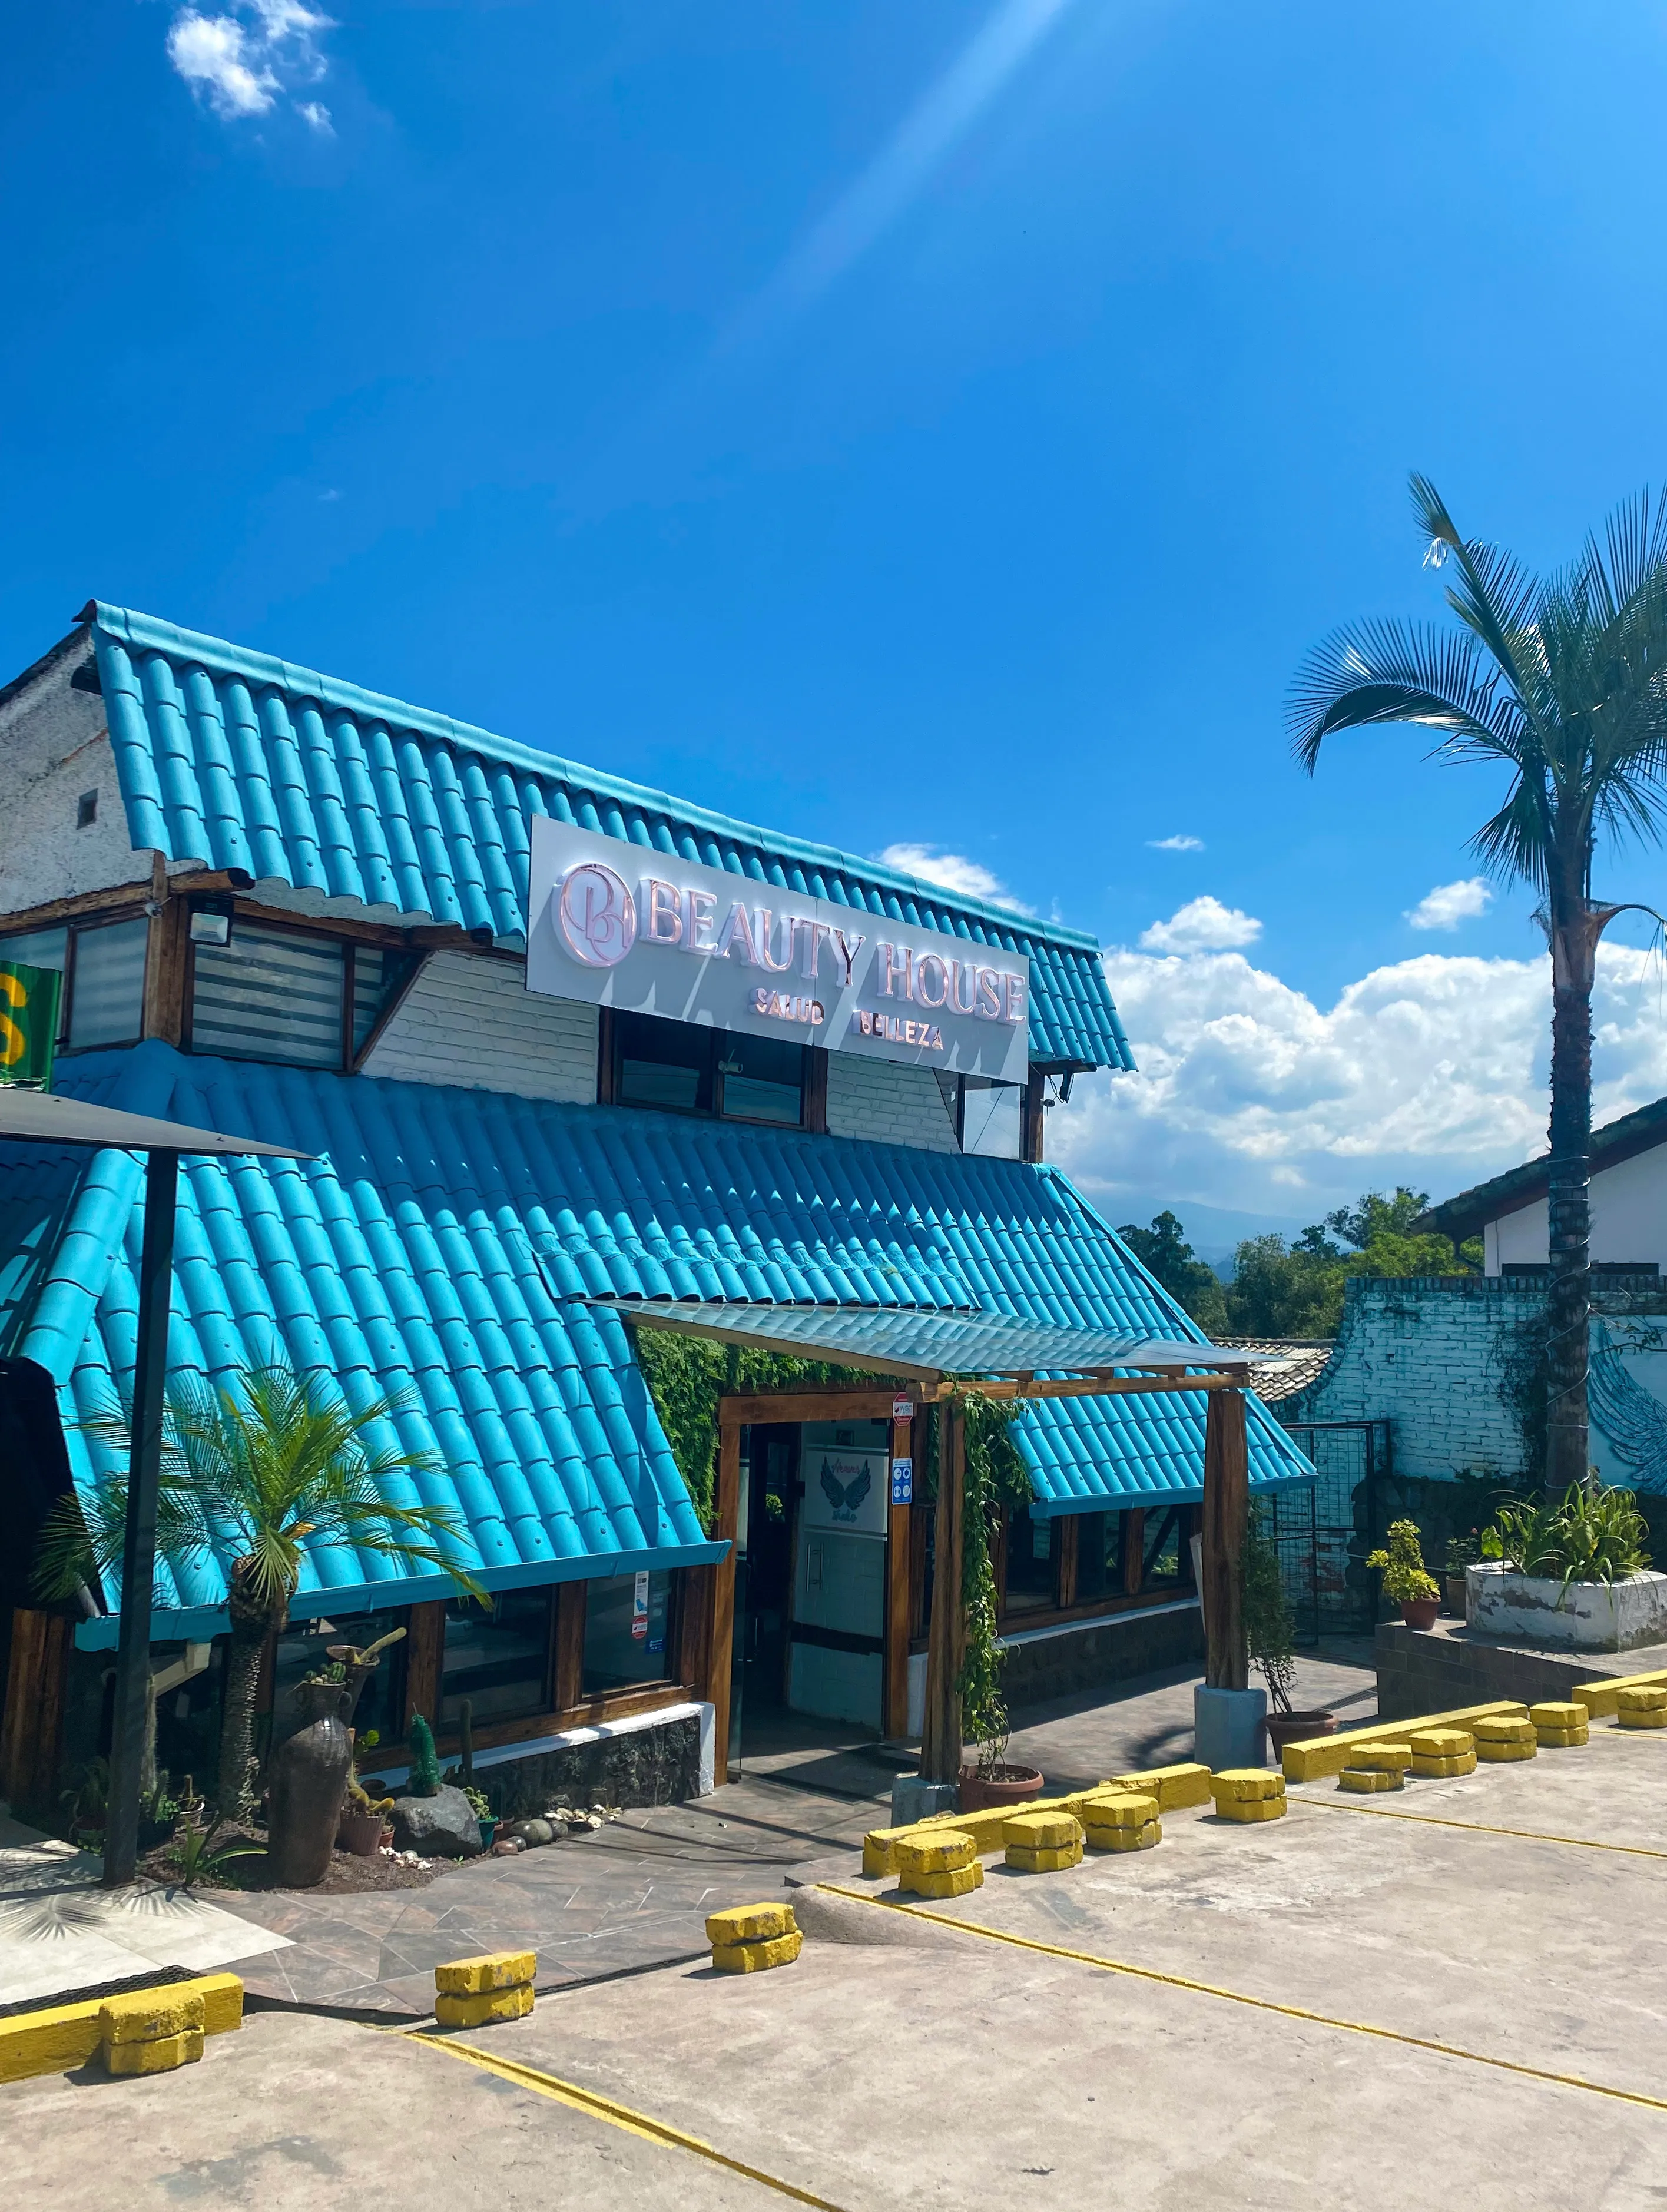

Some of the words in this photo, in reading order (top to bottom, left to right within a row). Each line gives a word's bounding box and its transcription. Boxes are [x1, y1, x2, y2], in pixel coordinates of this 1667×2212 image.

[639, 877, 866, 987] BEAUTY
[877, 942, 1026, 1024] HOUSE
[749, 987, 824, 1026] SALUD
[853, 1009, 944, 1051] BELLEZA
